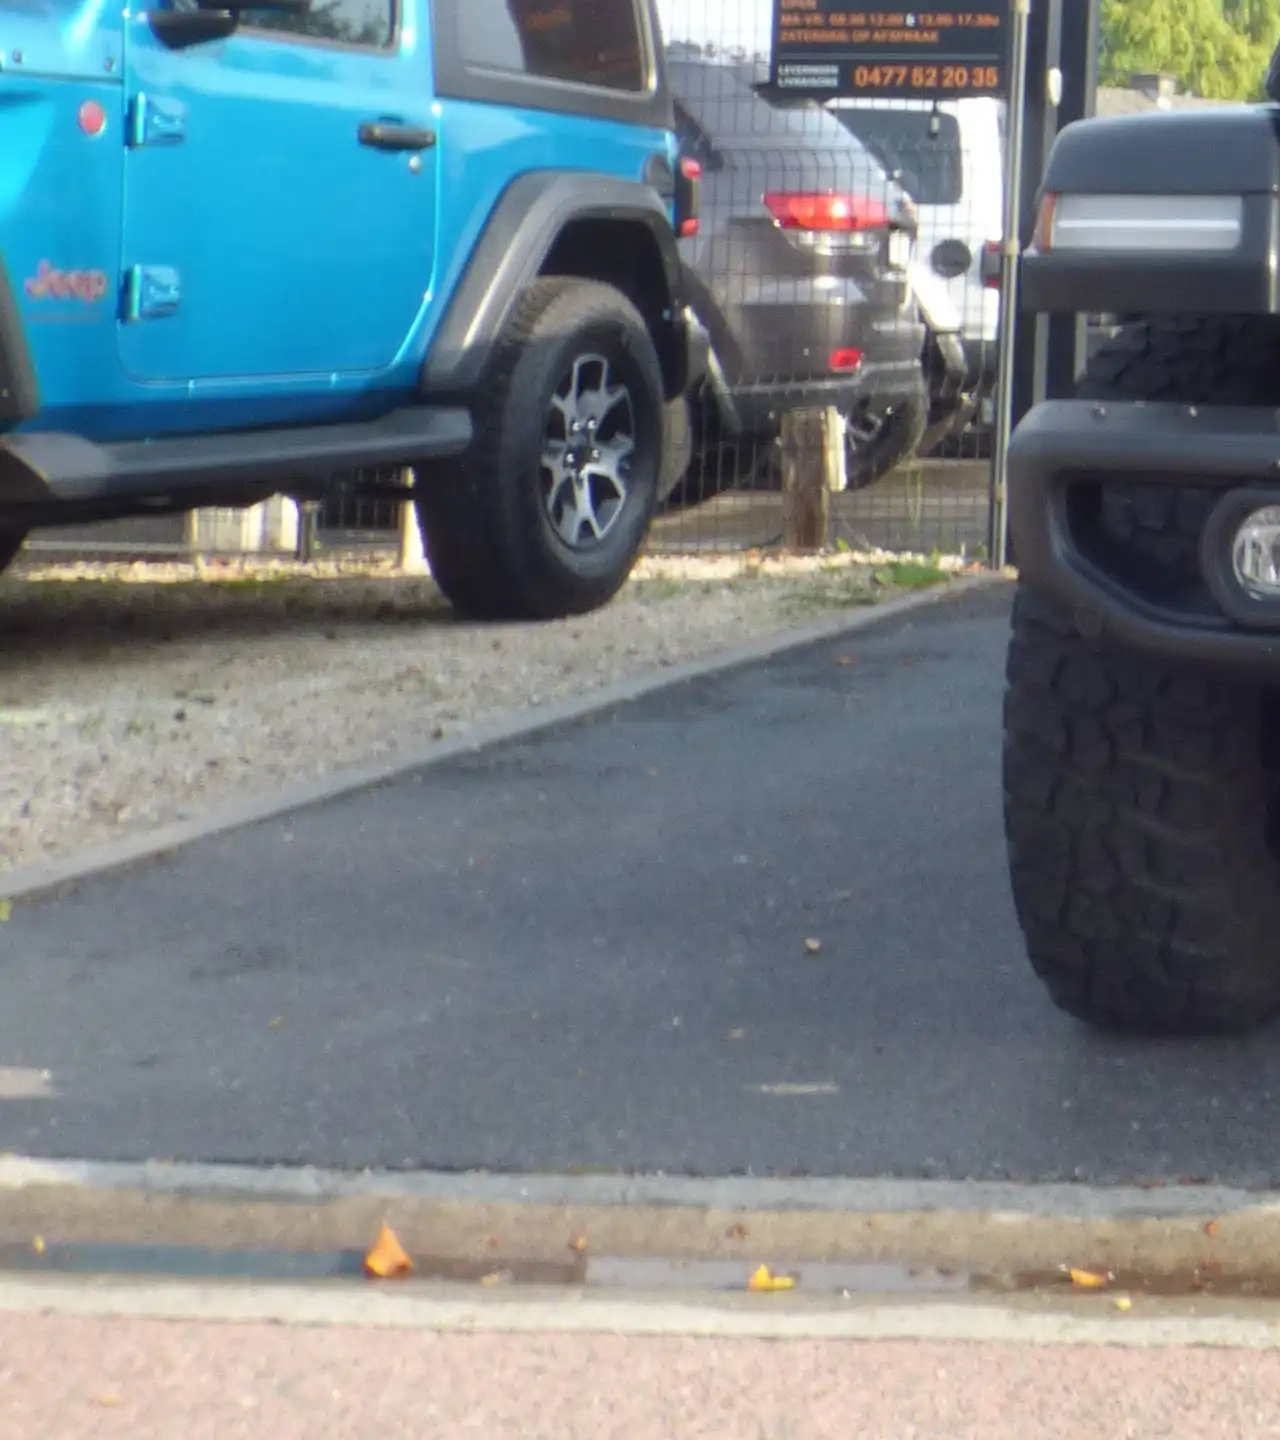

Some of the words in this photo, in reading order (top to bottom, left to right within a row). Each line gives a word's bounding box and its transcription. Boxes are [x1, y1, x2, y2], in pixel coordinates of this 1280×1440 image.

[855, 65, 908, 87] 0477
[942, 65, 968, 87] 20
[25, 259, 108, 306] Jeep
